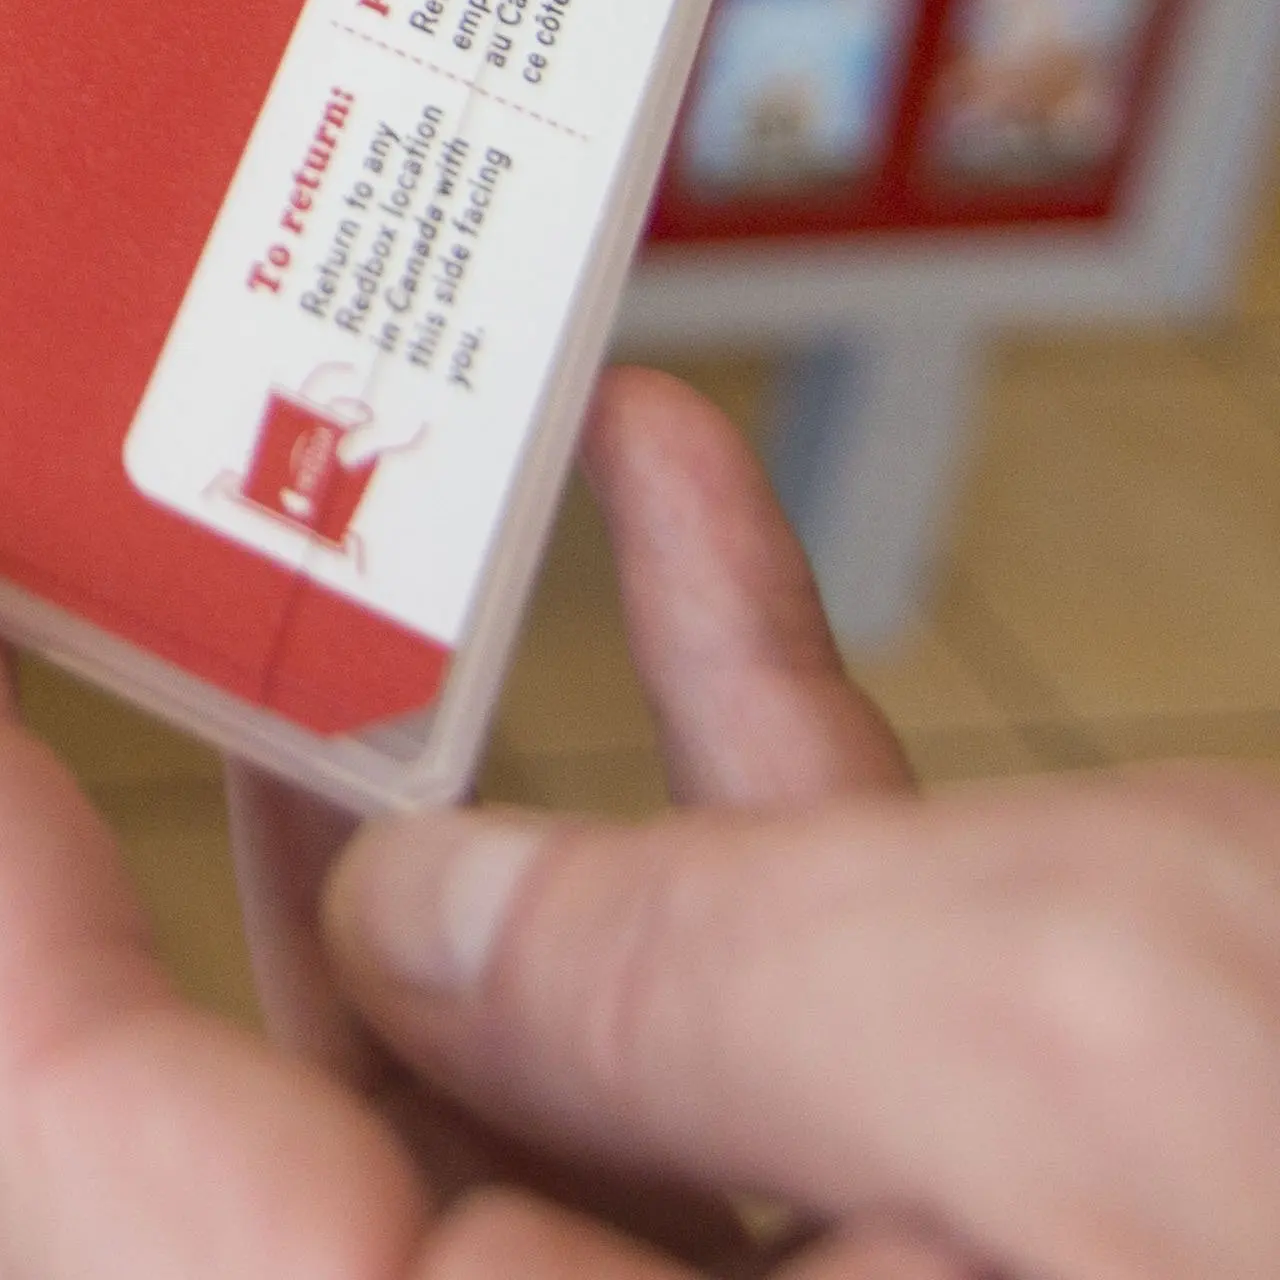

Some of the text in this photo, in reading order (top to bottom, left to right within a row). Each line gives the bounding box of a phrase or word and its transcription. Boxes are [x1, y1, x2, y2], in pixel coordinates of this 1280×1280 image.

[486, 35, 512, 68] au
[523, 53, 547, 84] ce
[246, 86, 355, 294] To return:
[299, 121, 401, 318] Return to any
[334, 104, 444, 334] Redbox location
[371, 137, 470, 353] in Canada with
[407, 146, 513, 368] this side facing
[446, 327, 486, 391] you.
